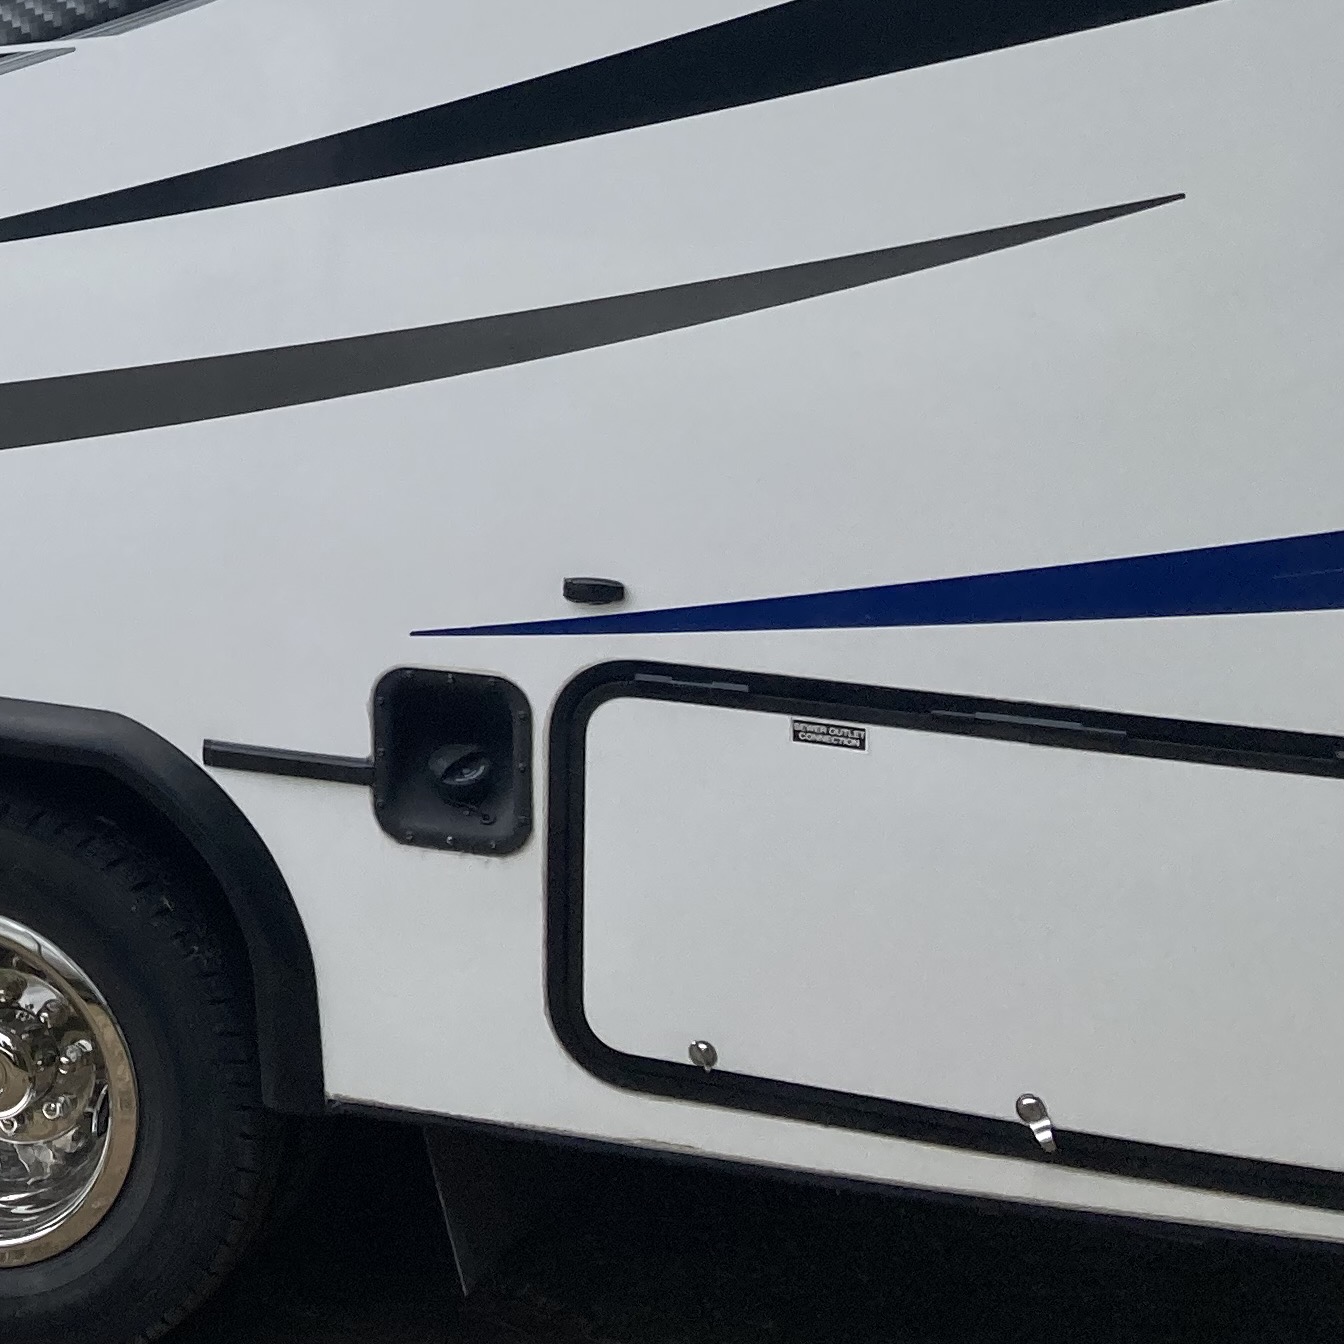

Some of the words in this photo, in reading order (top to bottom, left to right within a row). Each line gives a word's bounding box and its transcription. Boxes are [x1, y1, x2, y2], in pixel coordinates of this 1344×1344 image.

[793, 722, 827, 734] SEWER
[828, 727, 865, 739] OUTLET
[798, 731, 860, 747] CONNECTION
